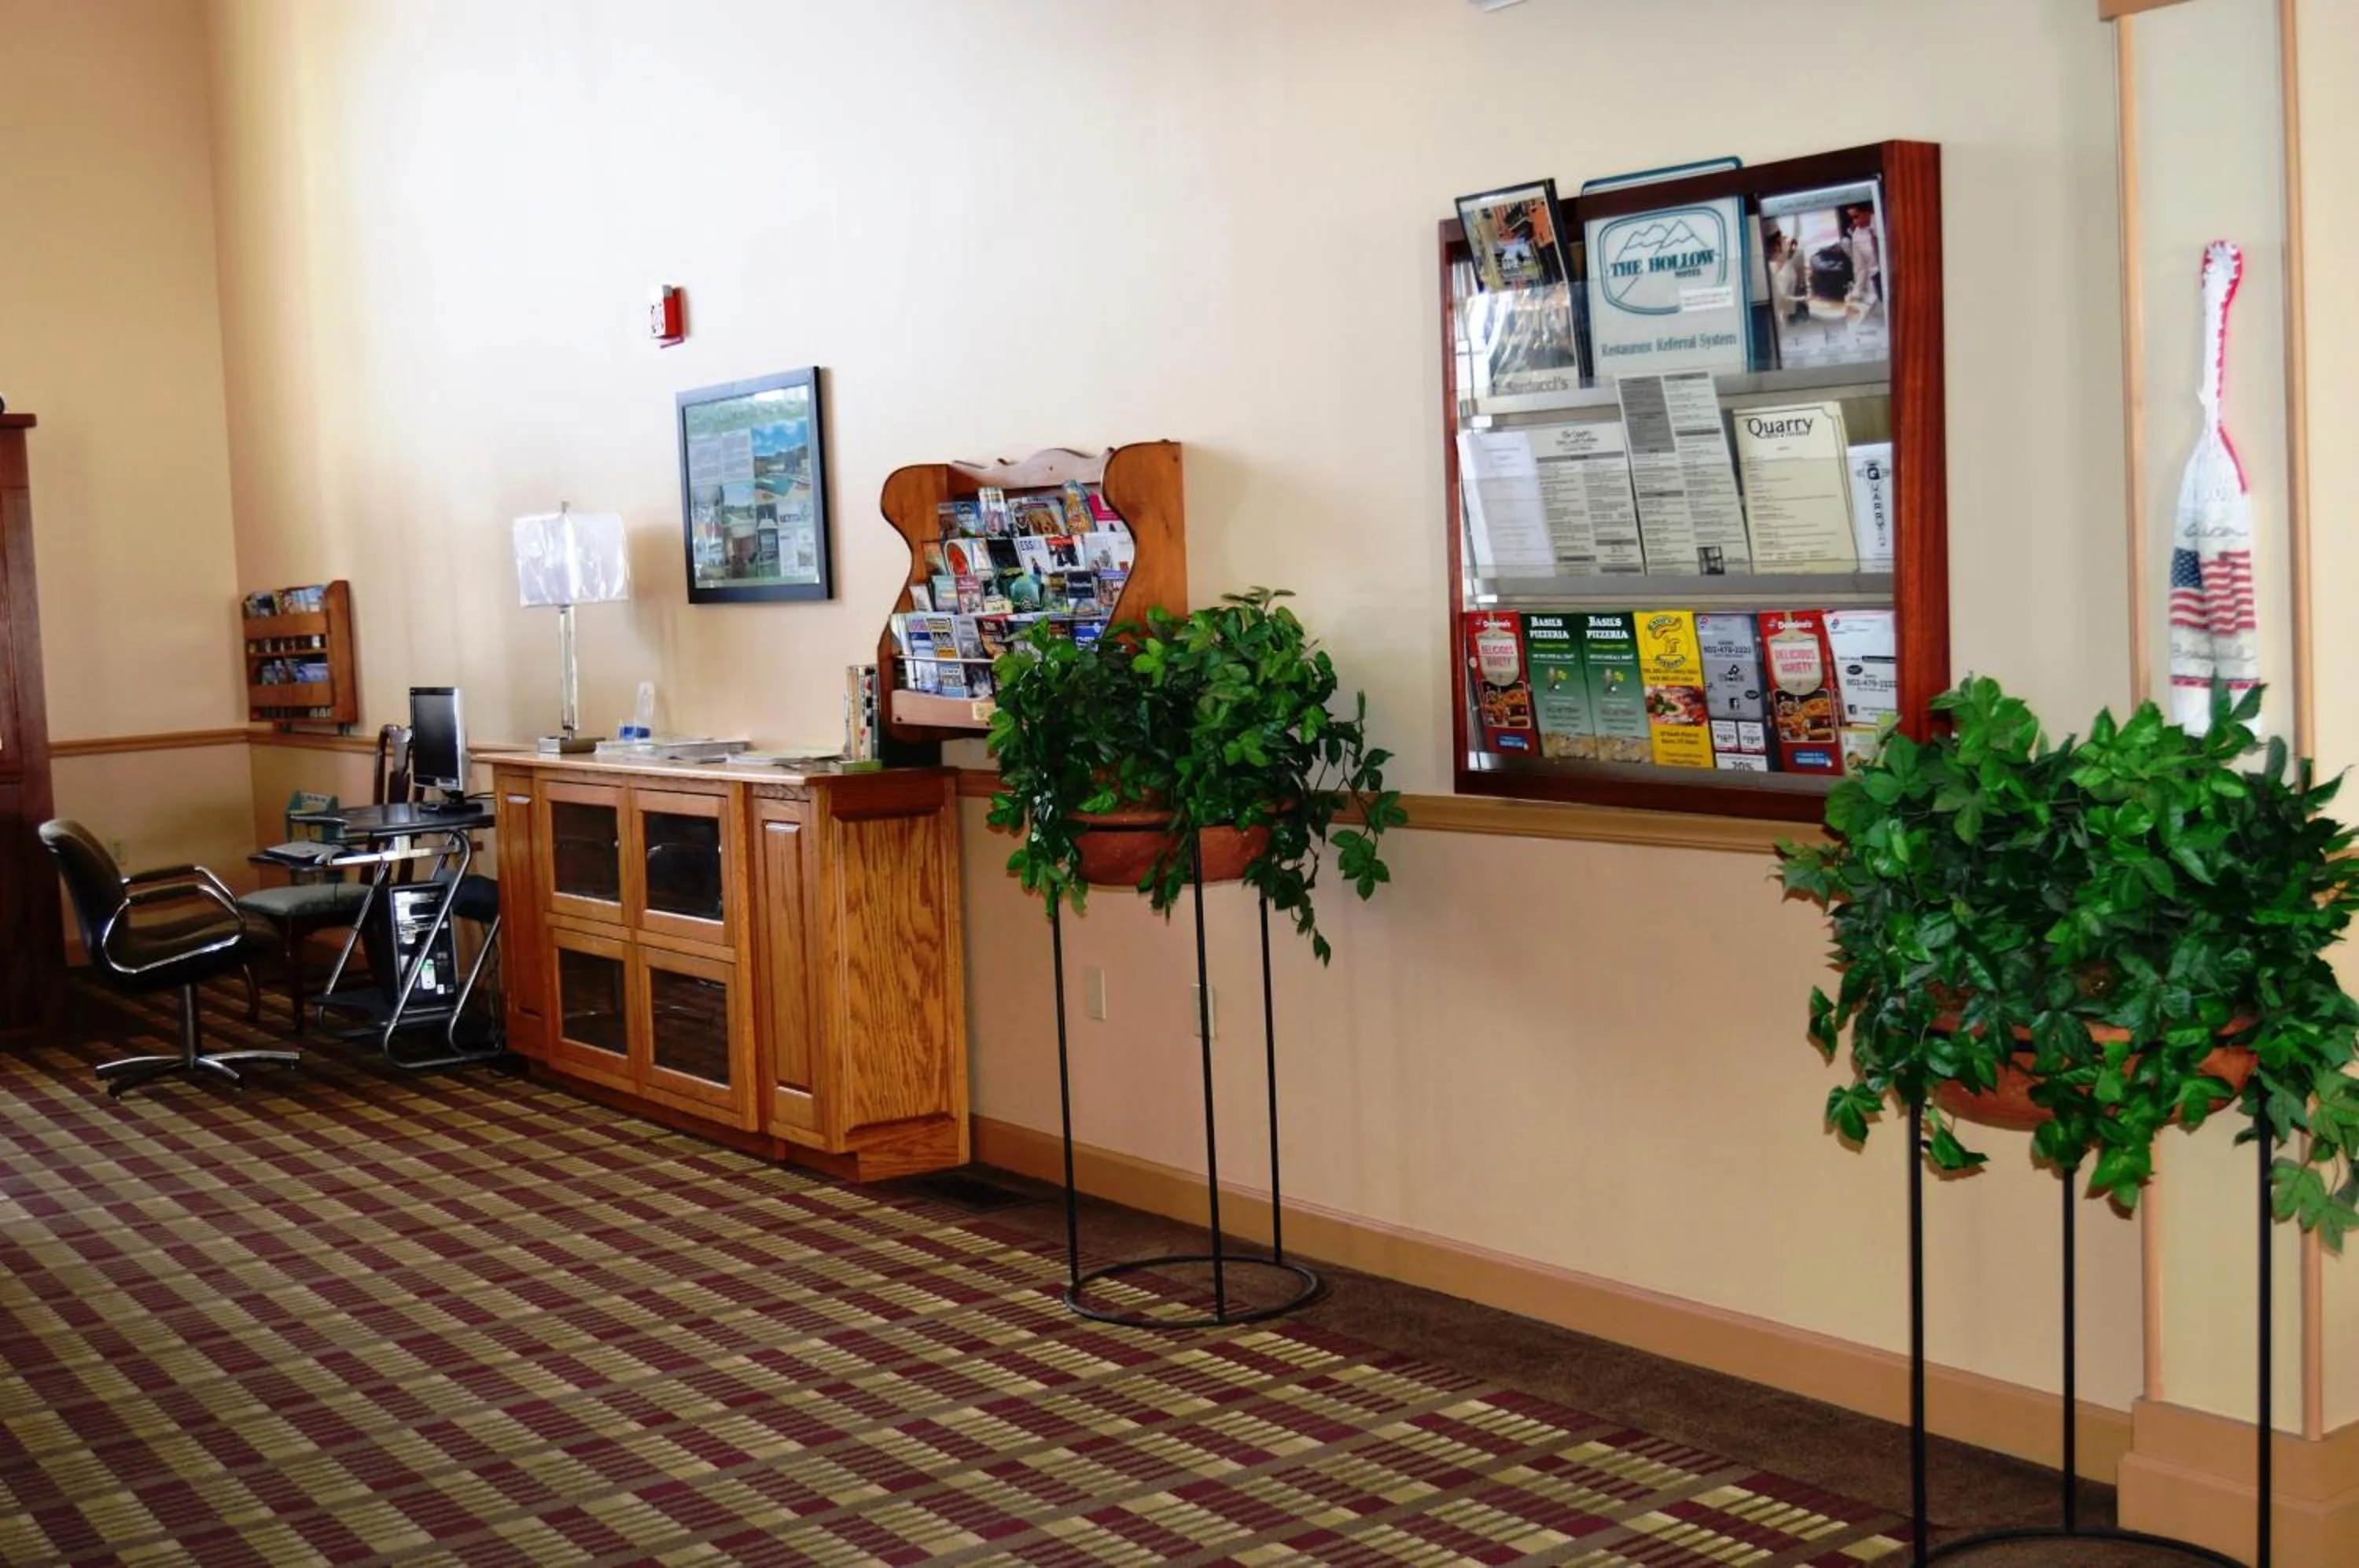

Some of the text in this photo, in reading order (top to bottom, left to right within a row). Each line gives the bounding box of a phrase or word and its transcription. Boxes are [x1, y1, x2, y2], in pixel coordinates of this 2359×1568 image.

[1610, 249, 1714, 277] THE HOLLOW
[1698, 333, 1737, 350] System
[1747, 417, 1813, 437] Quarry
[1588, 616, 1622, 627] BASIL'S
[1585, 630, 1629, 639] PIZZERIA
[1775, 649, 1815, 661] DELICIOUS
[1780, 663, 1812, 673] VARIETY
